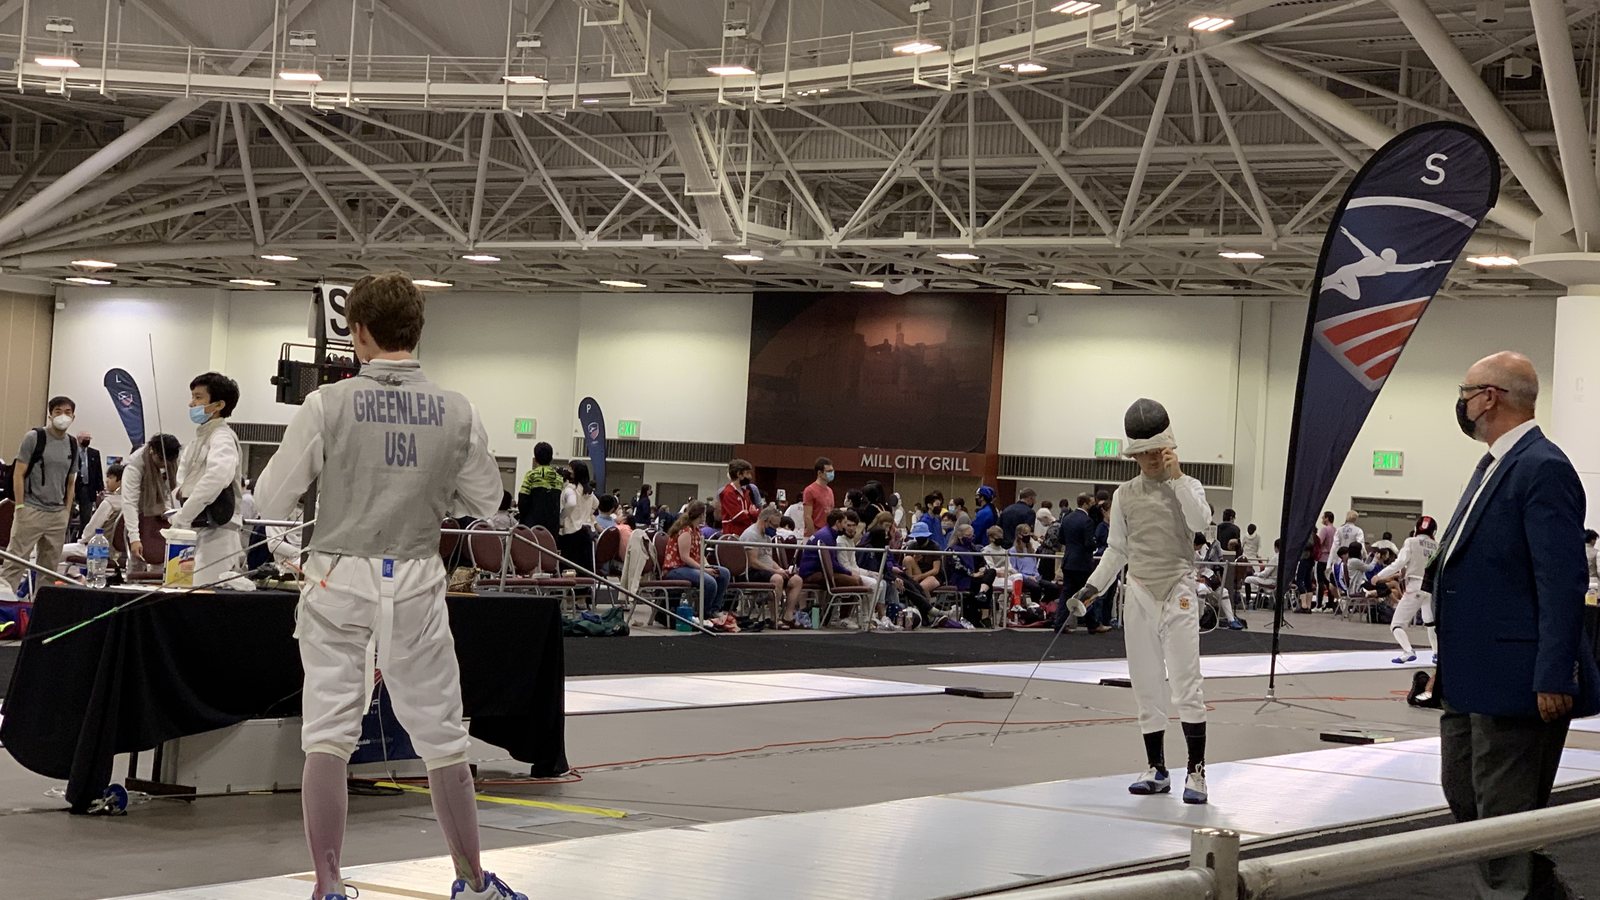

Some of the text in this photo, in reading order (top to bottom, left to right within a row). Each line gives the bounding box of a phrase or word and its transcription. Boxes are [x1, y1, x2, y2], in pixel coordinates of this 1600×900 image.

[1420, 153, 1448, 185] S
[329, 288, 351, 337] S
[115, 374, 122, 383] L
[353, 389, 446, 427] GREENLEAF
[586, 403, 592, 413] P
[514, 420, 533, 434] EXIT
[618, 421, 638, 436] EXIT
[385, 432, 418, 468] USA
[1096, 440, 1119, 456] EXIT
[860, 453, 970, 472] MILL CITY GRILL
[1374, 452, 1399, 469] EXIT
